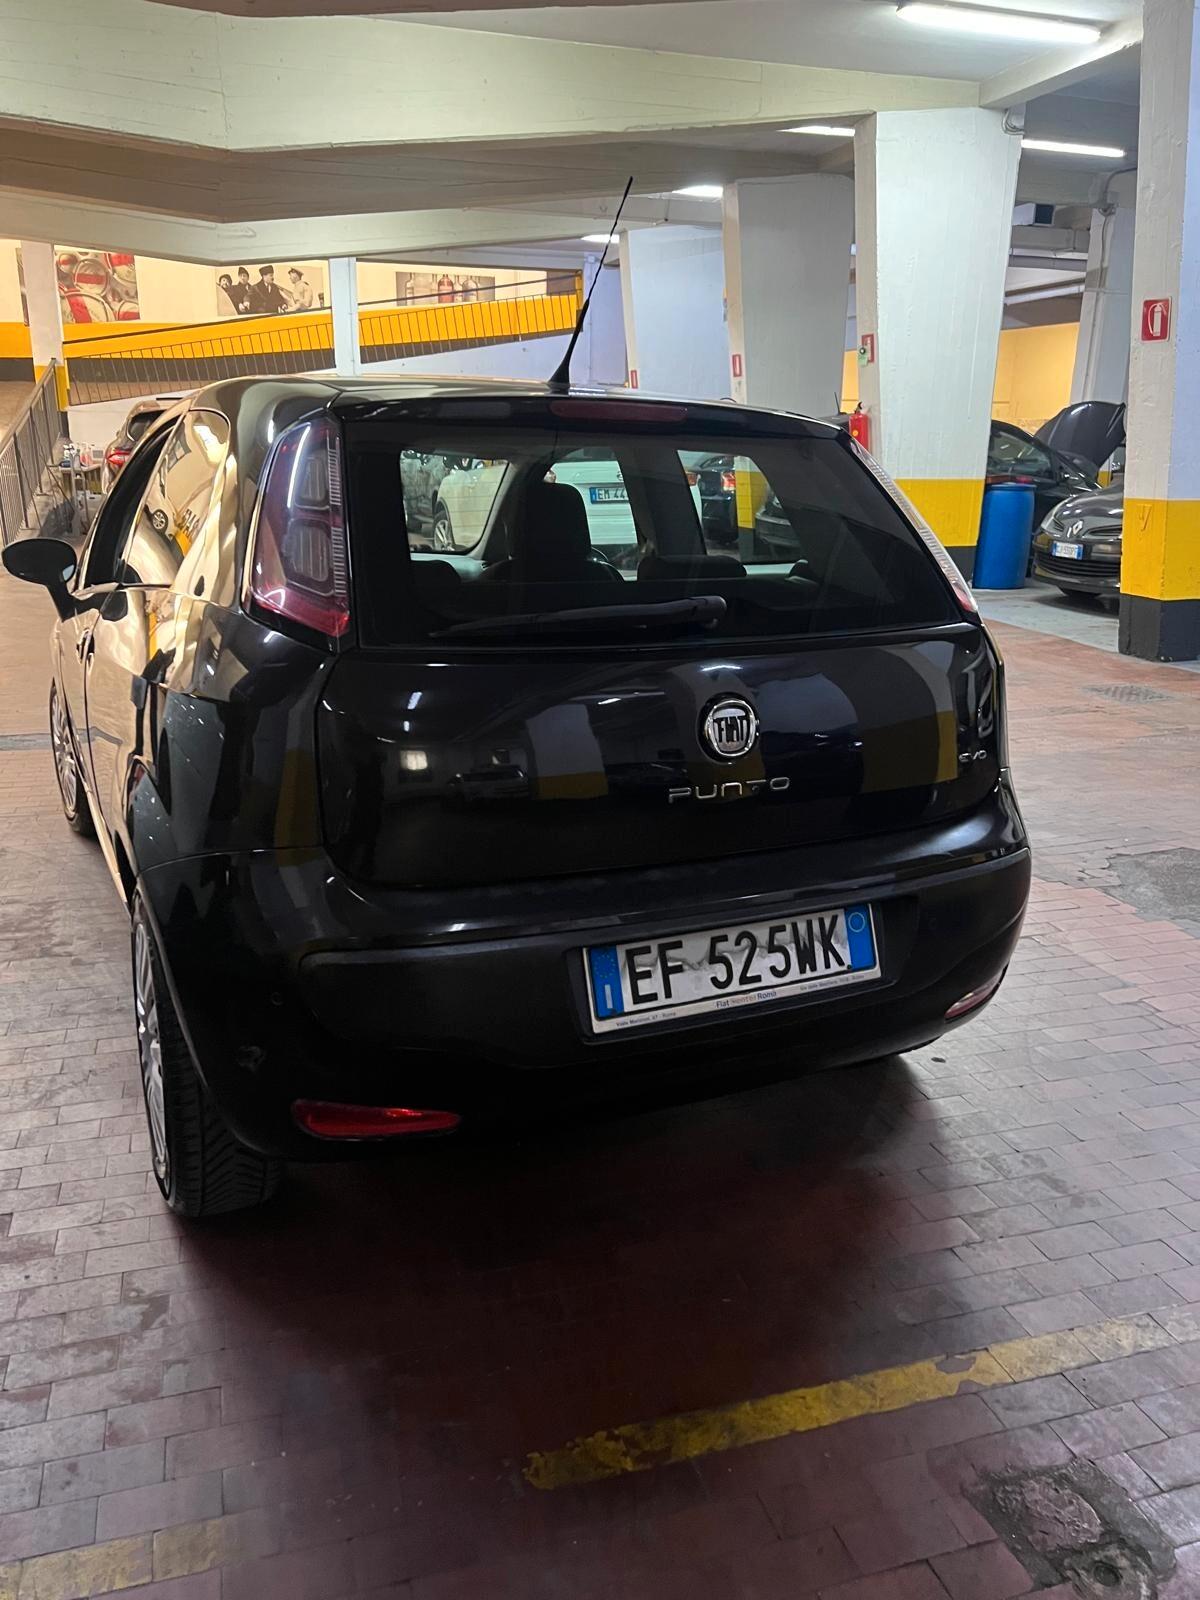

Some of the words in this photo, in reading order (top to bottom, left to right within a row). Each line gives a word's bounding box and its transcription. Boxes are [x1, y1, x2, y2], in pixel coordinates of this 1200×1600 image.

[597, 488, 610, 500] EM
[711, 713, 750, 744] FIAT
[668, 776, 790, 804] PUNTO
[626, 940, 684, 1005] EF
[708, 914, 846, 990] 525WK
[715, 999, 729, 1009] Fiat
[756, 990, 777, 1001] Roma
